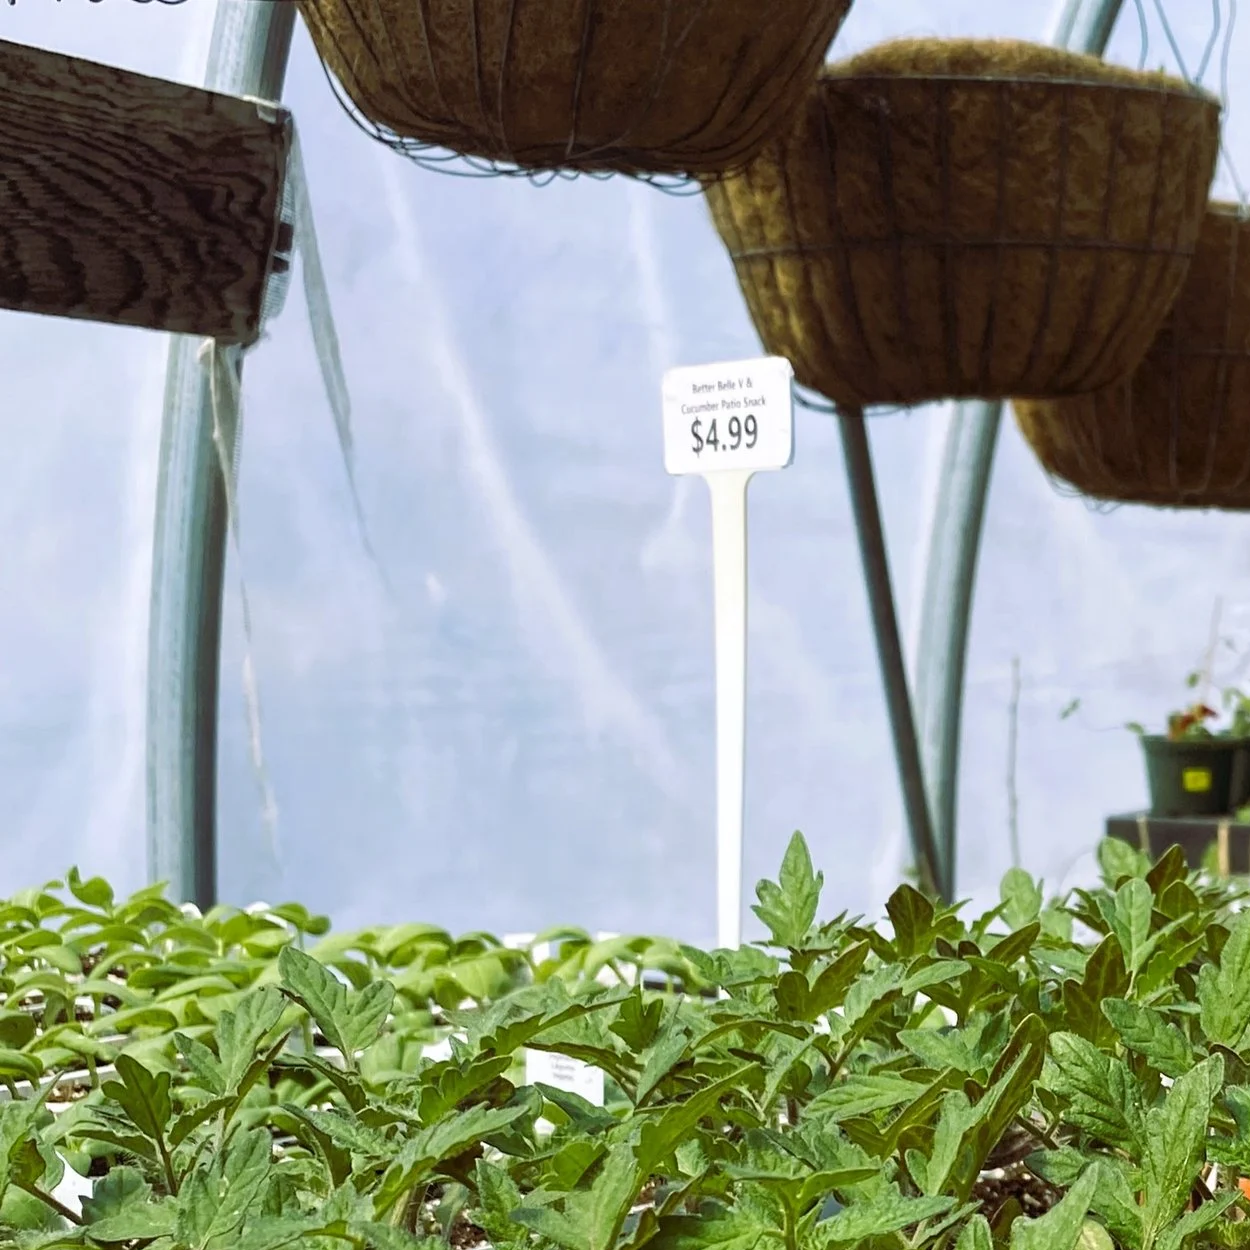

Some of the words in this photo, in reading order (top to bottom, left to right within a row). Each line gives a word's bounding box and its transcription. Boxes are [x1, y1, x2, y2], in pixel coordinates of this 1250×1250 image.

[692, 383, 715, 394] Better
[738, 378, 743, 388] V
[746, 377, 753, 388] &
[681, 400, 718, 415] Cucumber
[721, 398, 741, 410] Patio
[743, 395, 766, 408] Snack
[691, 414, 758, 458] $4.99
